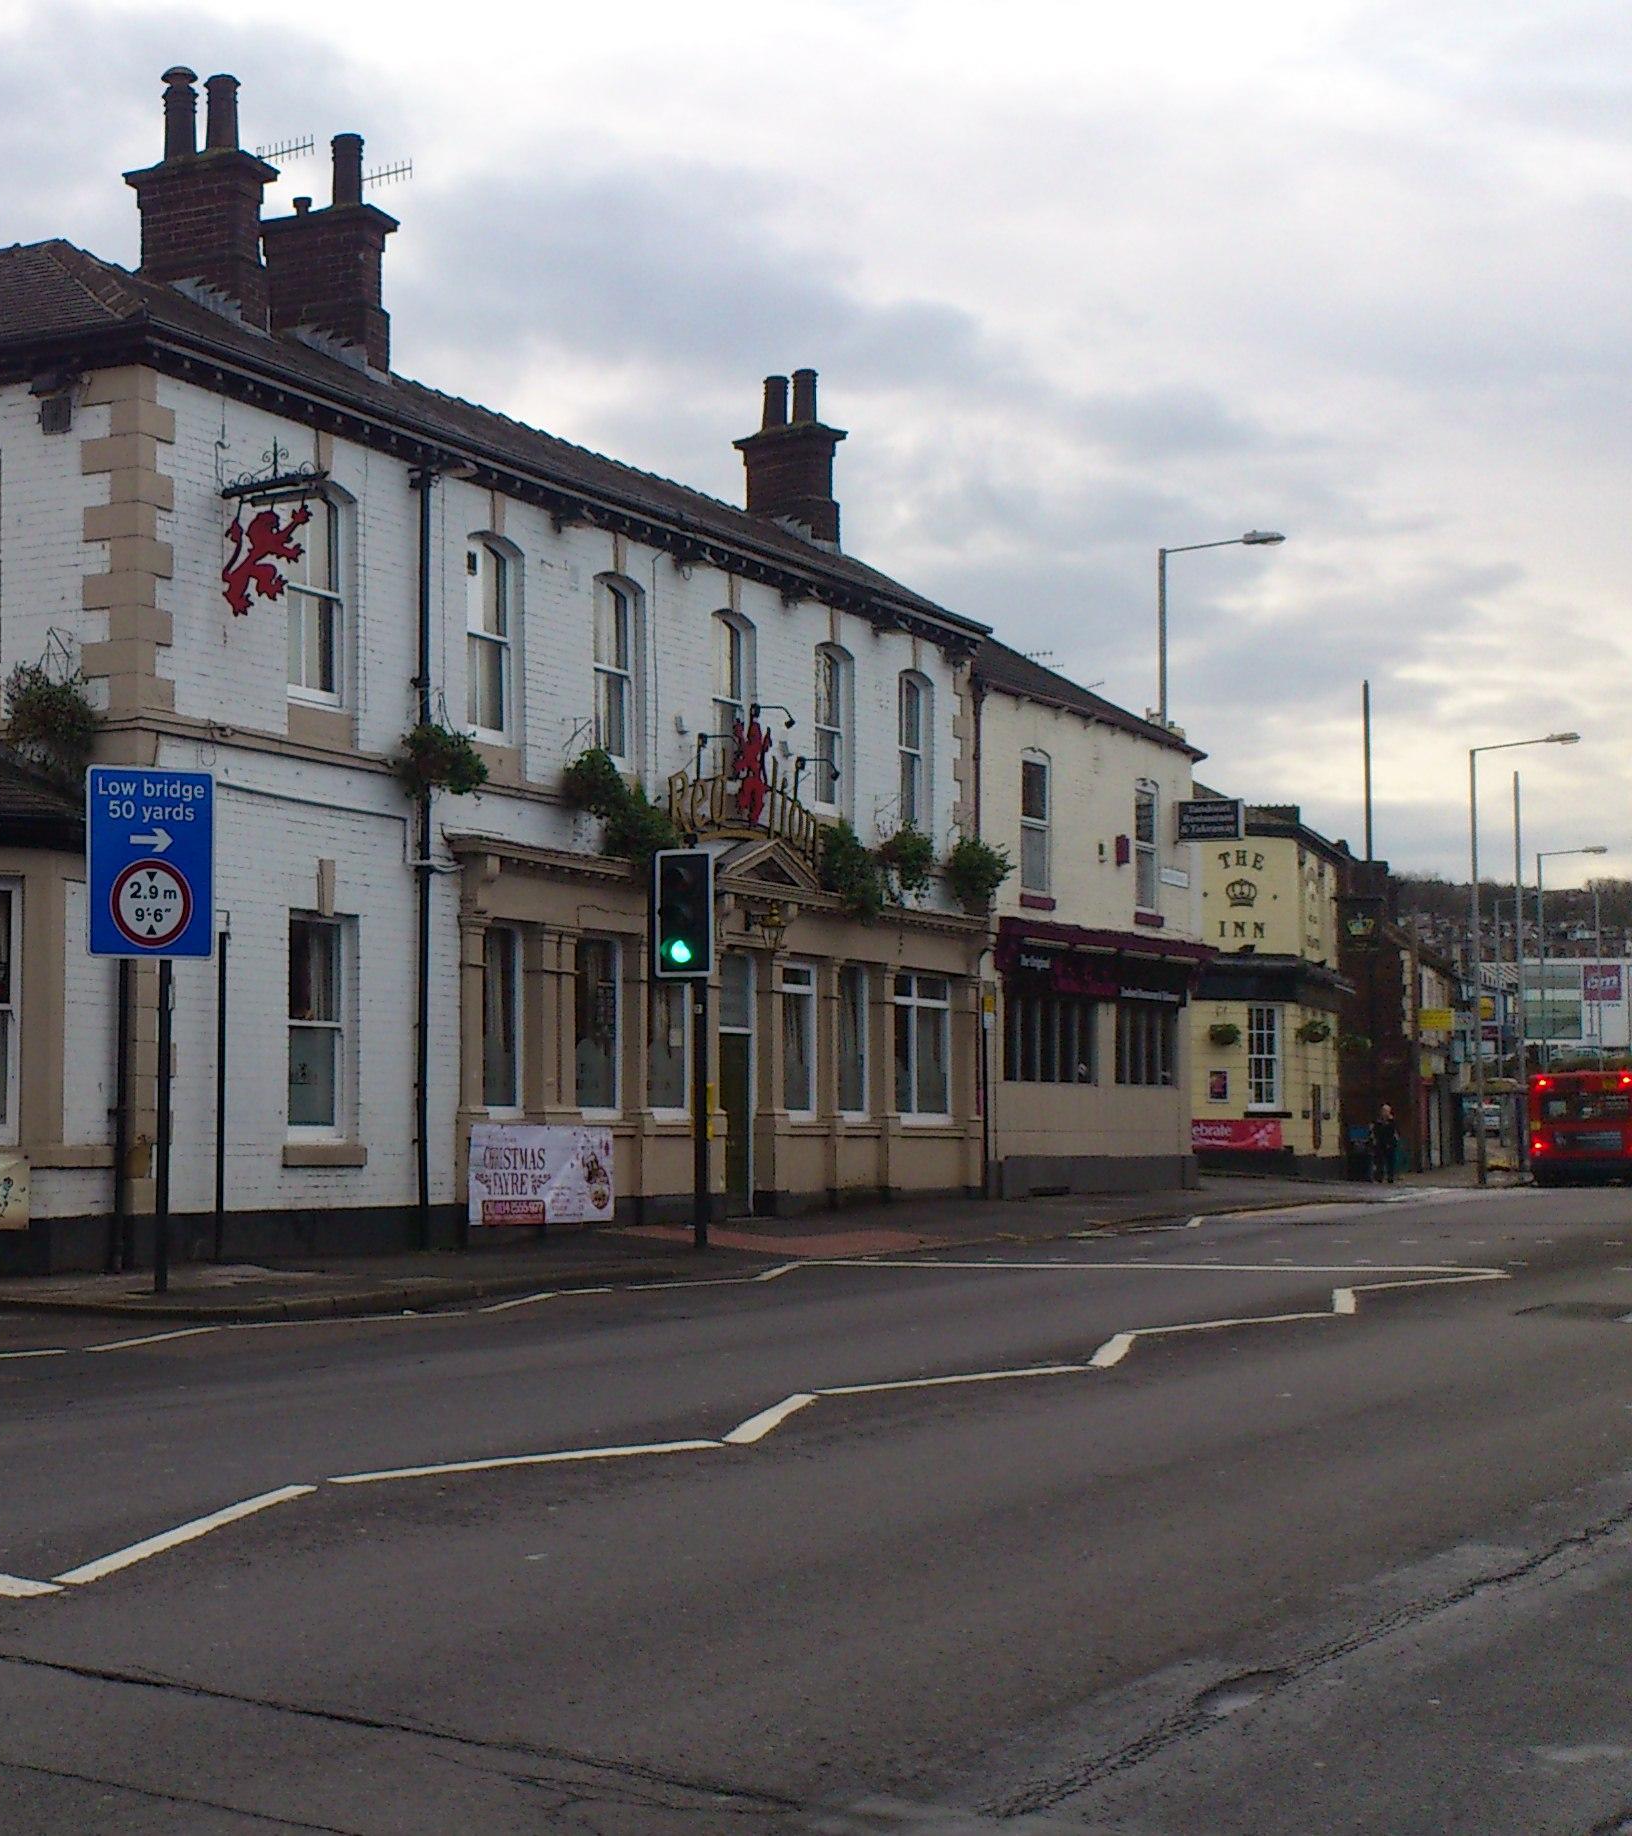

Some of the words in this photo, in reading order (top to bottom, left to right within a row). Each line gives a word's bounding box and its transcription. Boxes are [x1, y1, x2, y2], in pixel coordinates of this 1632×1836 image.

[98, 776, 137, 796] Low
[143, 780, 205, 802] bridge
[668, 741, 729, 834] Red
[108, 801, 136, 819] 50
[142, 803, 195, 822] yards
[1218, 850, 1265, 871] THE
[129, 882, 159, 900] 2.9
[163, 889, 178, 900] m
[1219, 921, 1266, 939] INN
